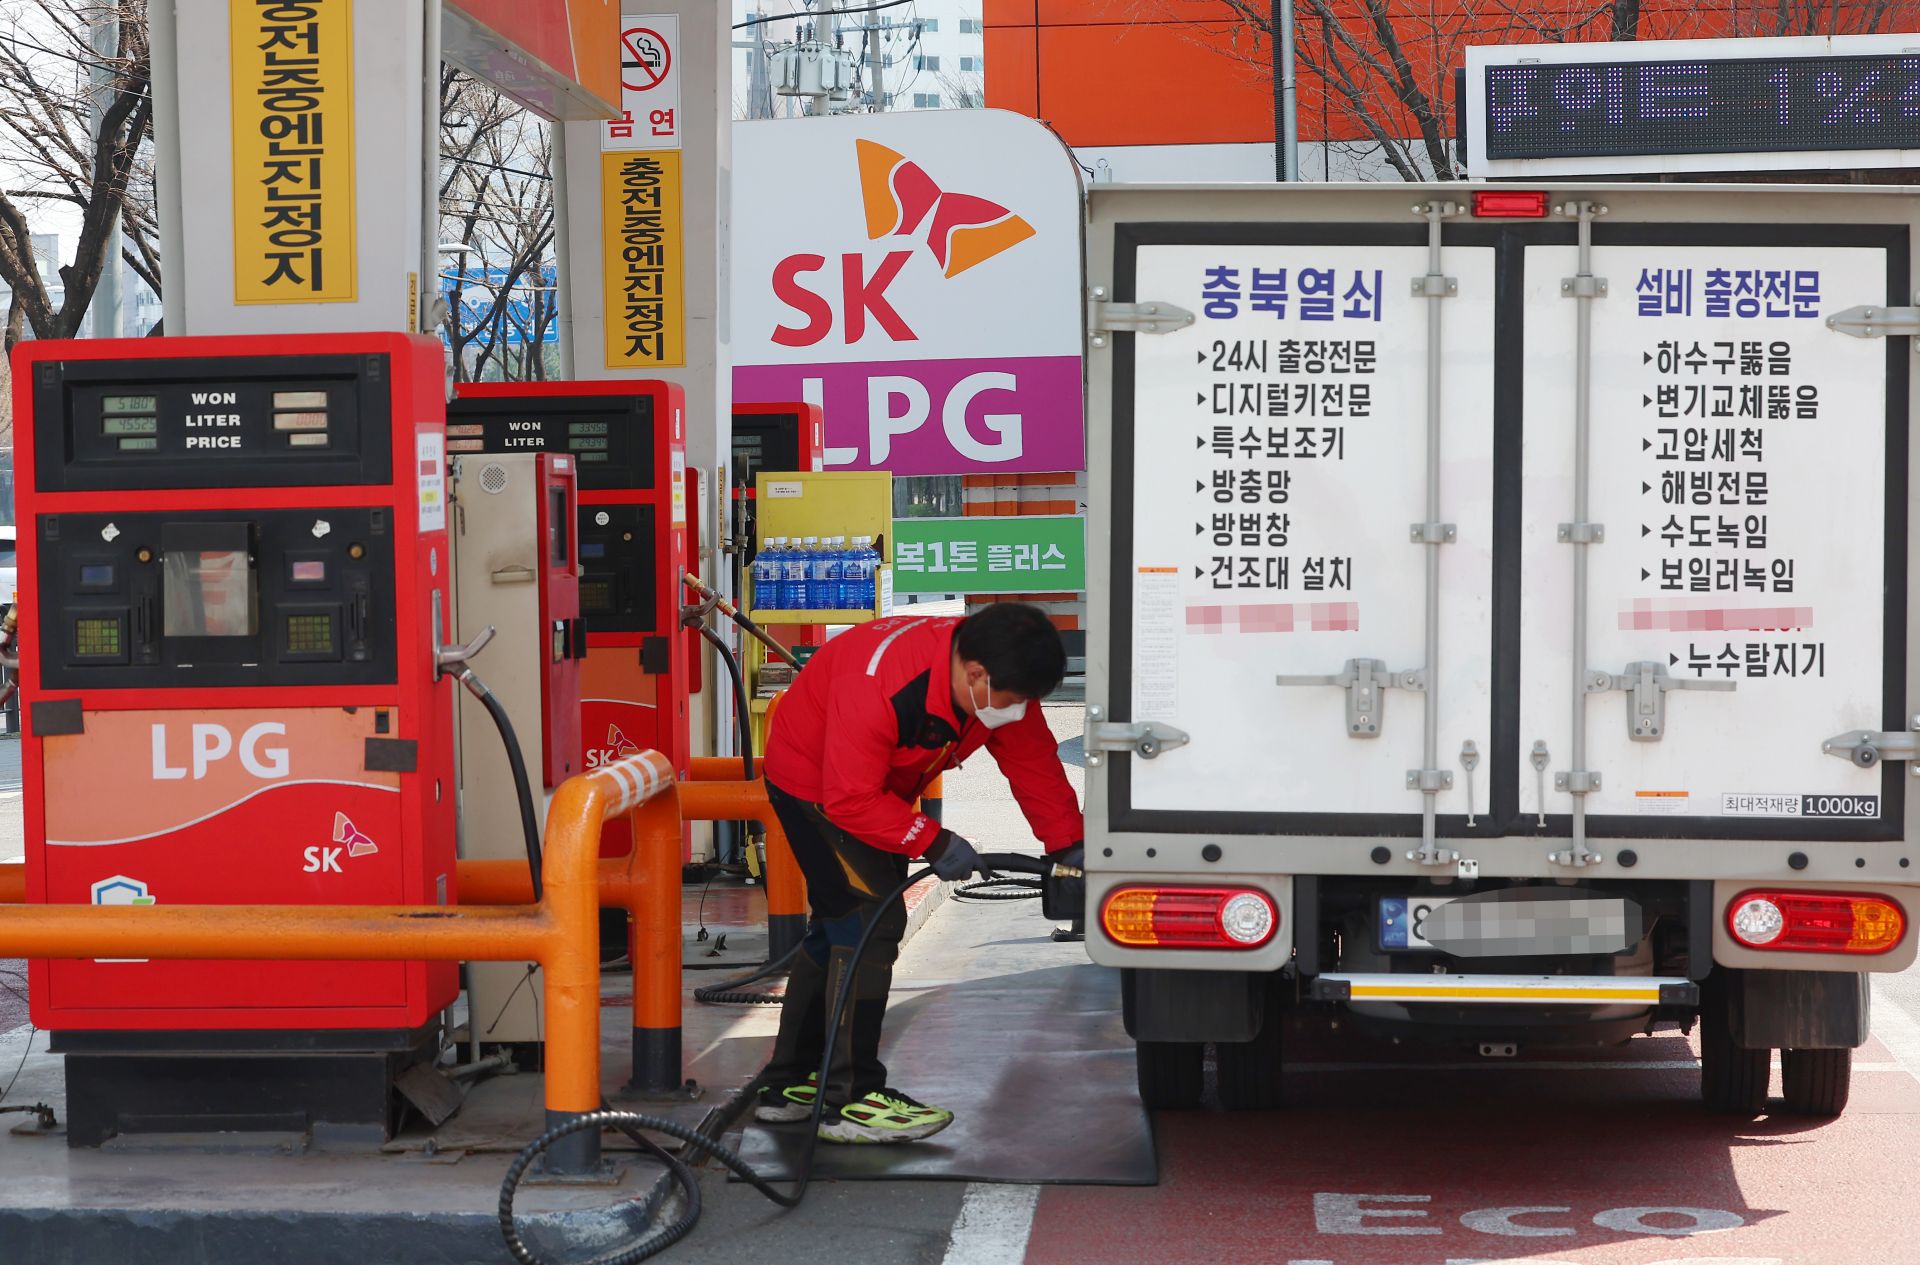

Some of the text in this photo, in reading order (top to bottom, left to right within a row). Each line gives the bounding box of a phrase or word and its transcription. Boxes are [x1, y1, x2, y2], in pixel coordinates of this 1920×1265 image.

[771, 251, 920, 347] SK
[1202, 265, 1384, 322] 충북열쇠
[1635, 268, 1821, 318] 설비 출장전문
[1212, 339, 1377, 374] 24시 출장전문
[1657, 341, 1791, 376] 하수구뚫음
[191, 392, 236, 405] WON
[1212, 383, 1371, 417] 디지털키전문
[1657, 384, 1819, 420] 변기교체뚫음
[185, 414, 241, 427] LITER
[508, 421, 541, 431] WON
[802, 371, 1023, 466] LPG
[186, 435, 242, 449] PRICE
[504, 437, 545, 447] LITER
[1211, 427, 1344, 460] 특수보조키
[1656, 428, 1763, 462] 고압세척
[1212, 469, 1291, 504] 방충망
[1661, 471, 1769, 505] 해빙전문
[1212, 513, 1290, 547] 방범창
[1661, 515, 1767, 549] 수도녹임
[987, 543, 1066, 572] 플러스
[1210, 556, 1352, 591] 건조대 설치
[1660, 558, 1794, 593] 보일러녹임
[1688, 642, 1825, 678] 누수탐지기
[152, 721, 290, 780] LPG
[585, 748, 616, 768] SK
[1725, 796, 1799, 813] 최대적재량
[303, 846, 344, 873] SK
[1313, 1191, 1746, 1238] ECO
